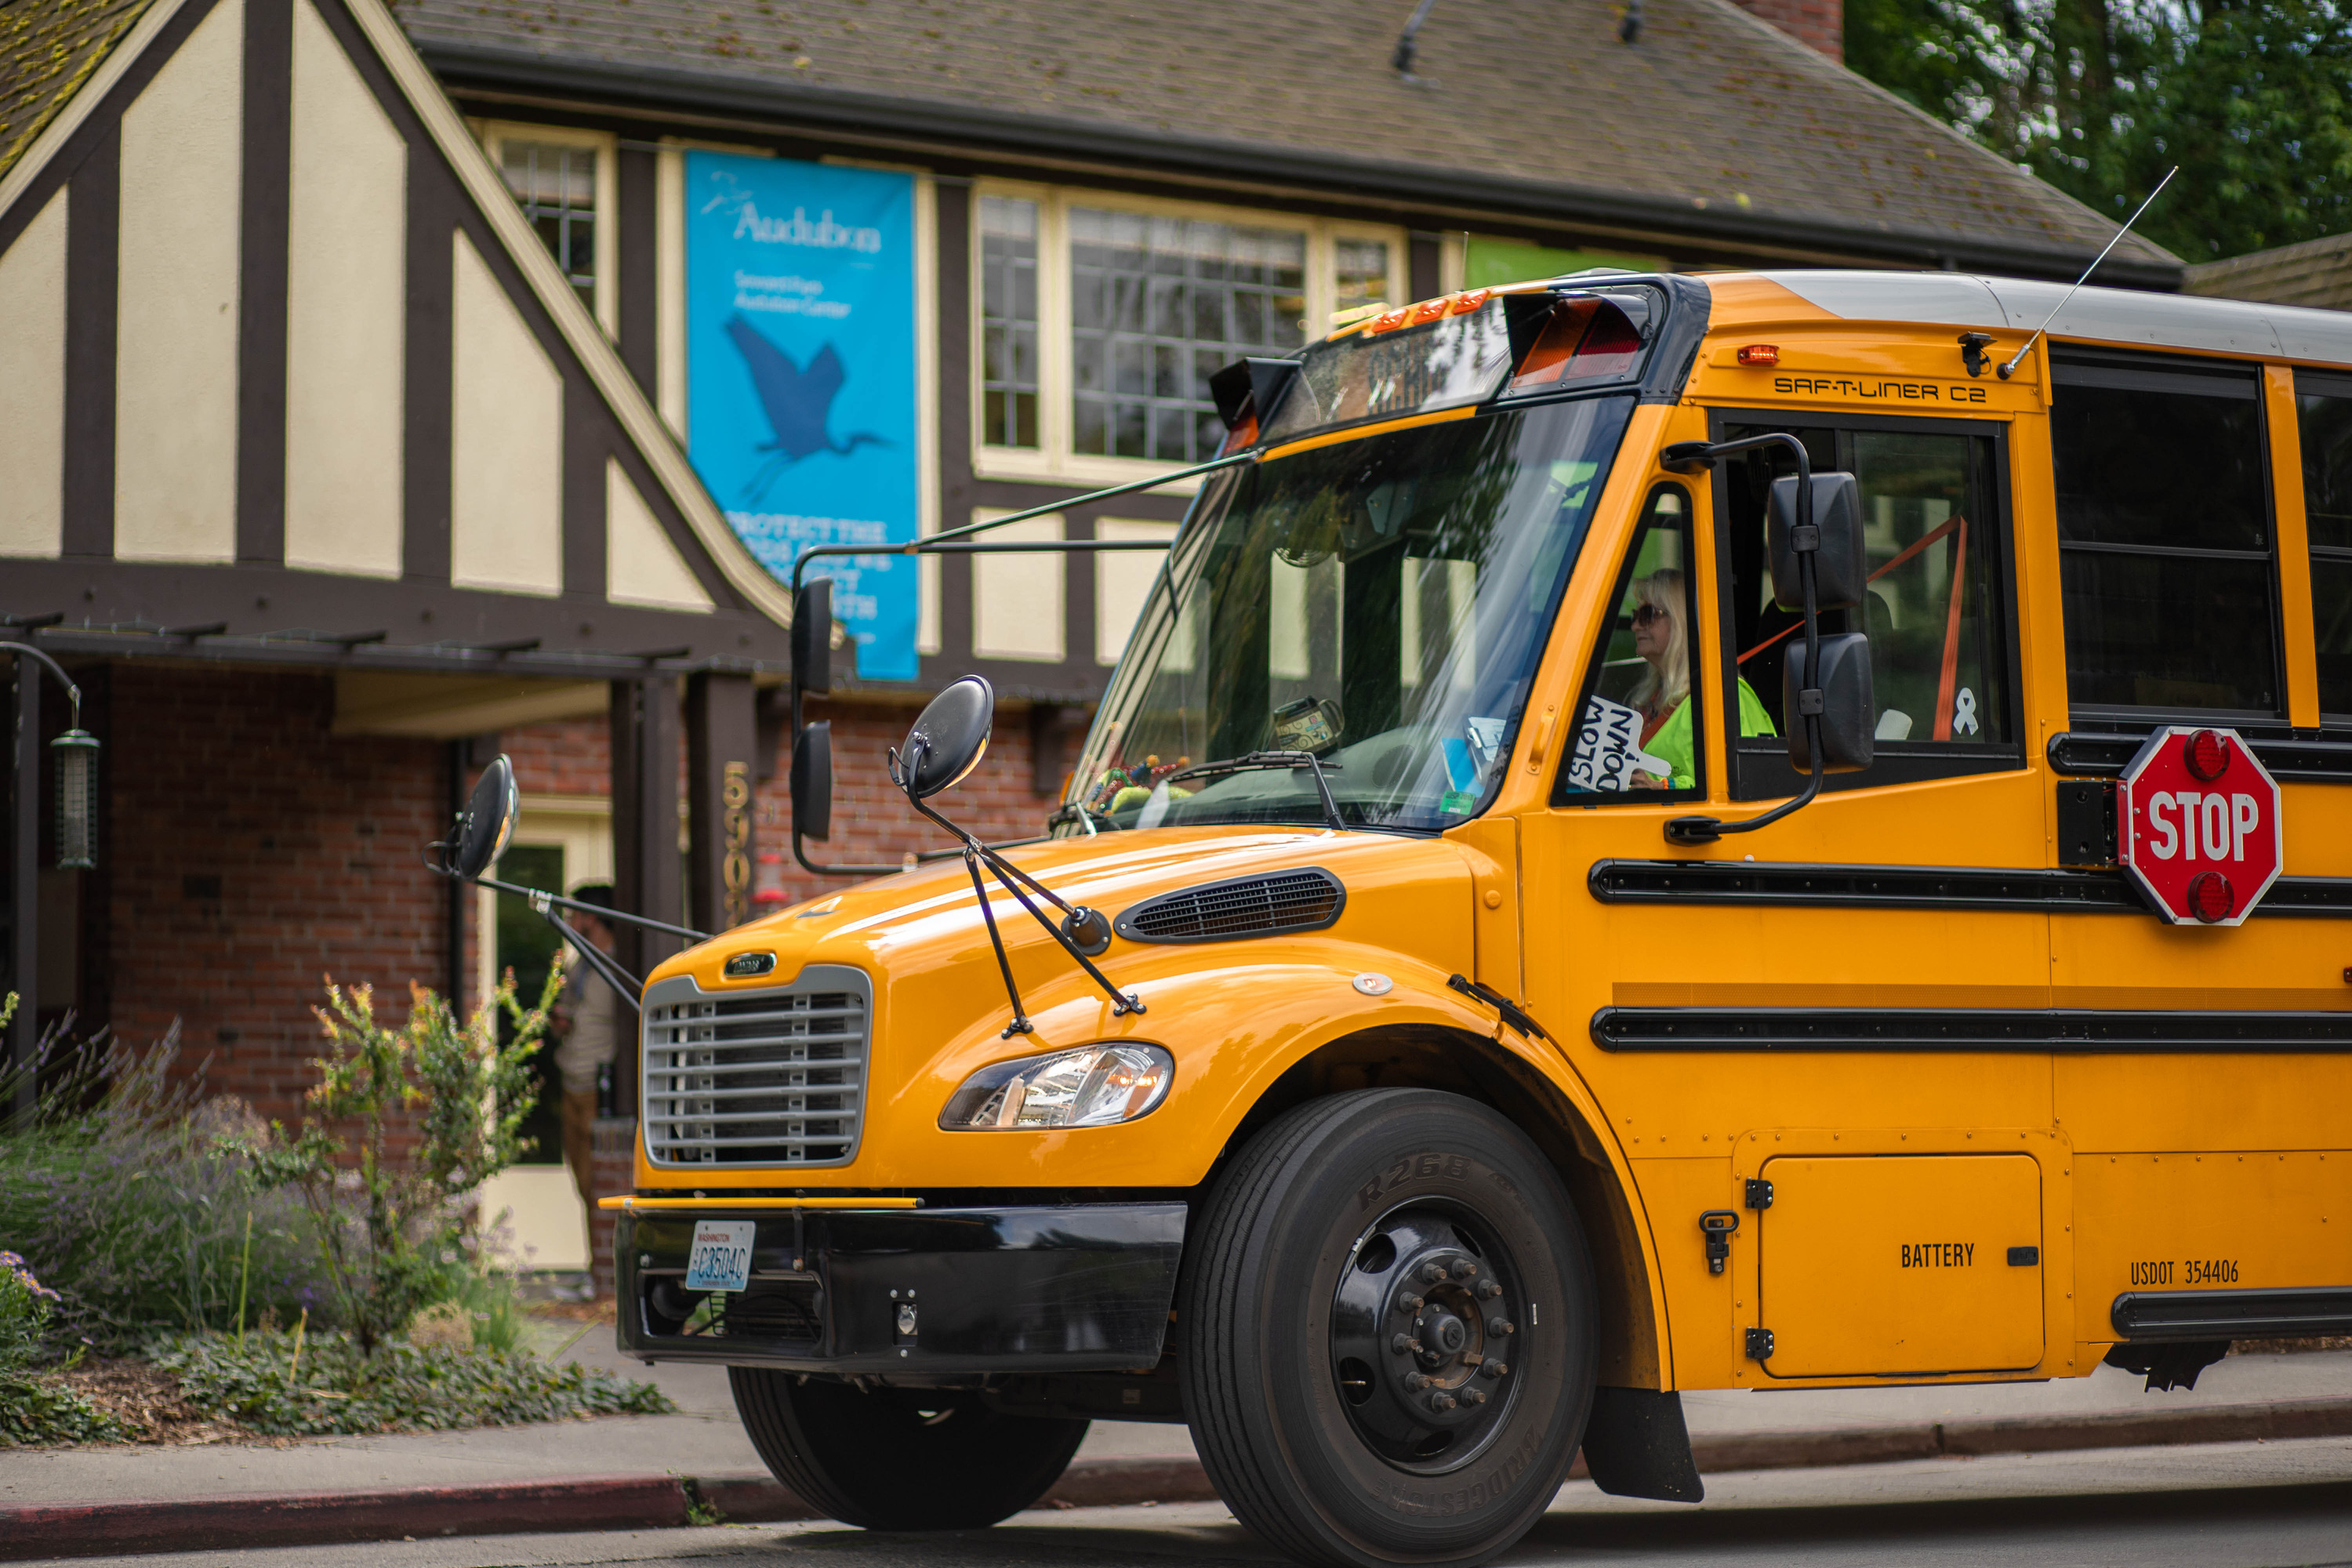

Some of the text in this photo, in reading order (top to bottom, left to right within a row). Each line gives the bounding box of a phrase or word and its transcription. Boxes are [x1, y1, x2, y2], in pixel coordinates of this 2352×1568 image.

[733, 200, 882, 254] Audubon
[1774, 377, 1987, 403] SAF-T-LINER C2
[837, 517, 887, 544] THE
[1569, 699, 1604, 784] SLOW
[2148, 790, 2259, 862] STOP
[1356, 1152, 1475, 1214] R268
[697, 1233, 730, 1243] WASHINGTON
[699, 1247, 746, 1279] C3504C
[1901, 1243, 1975, 1268] BATTERY
[2131, 1259, 2239, 1285] USDOT 354406
